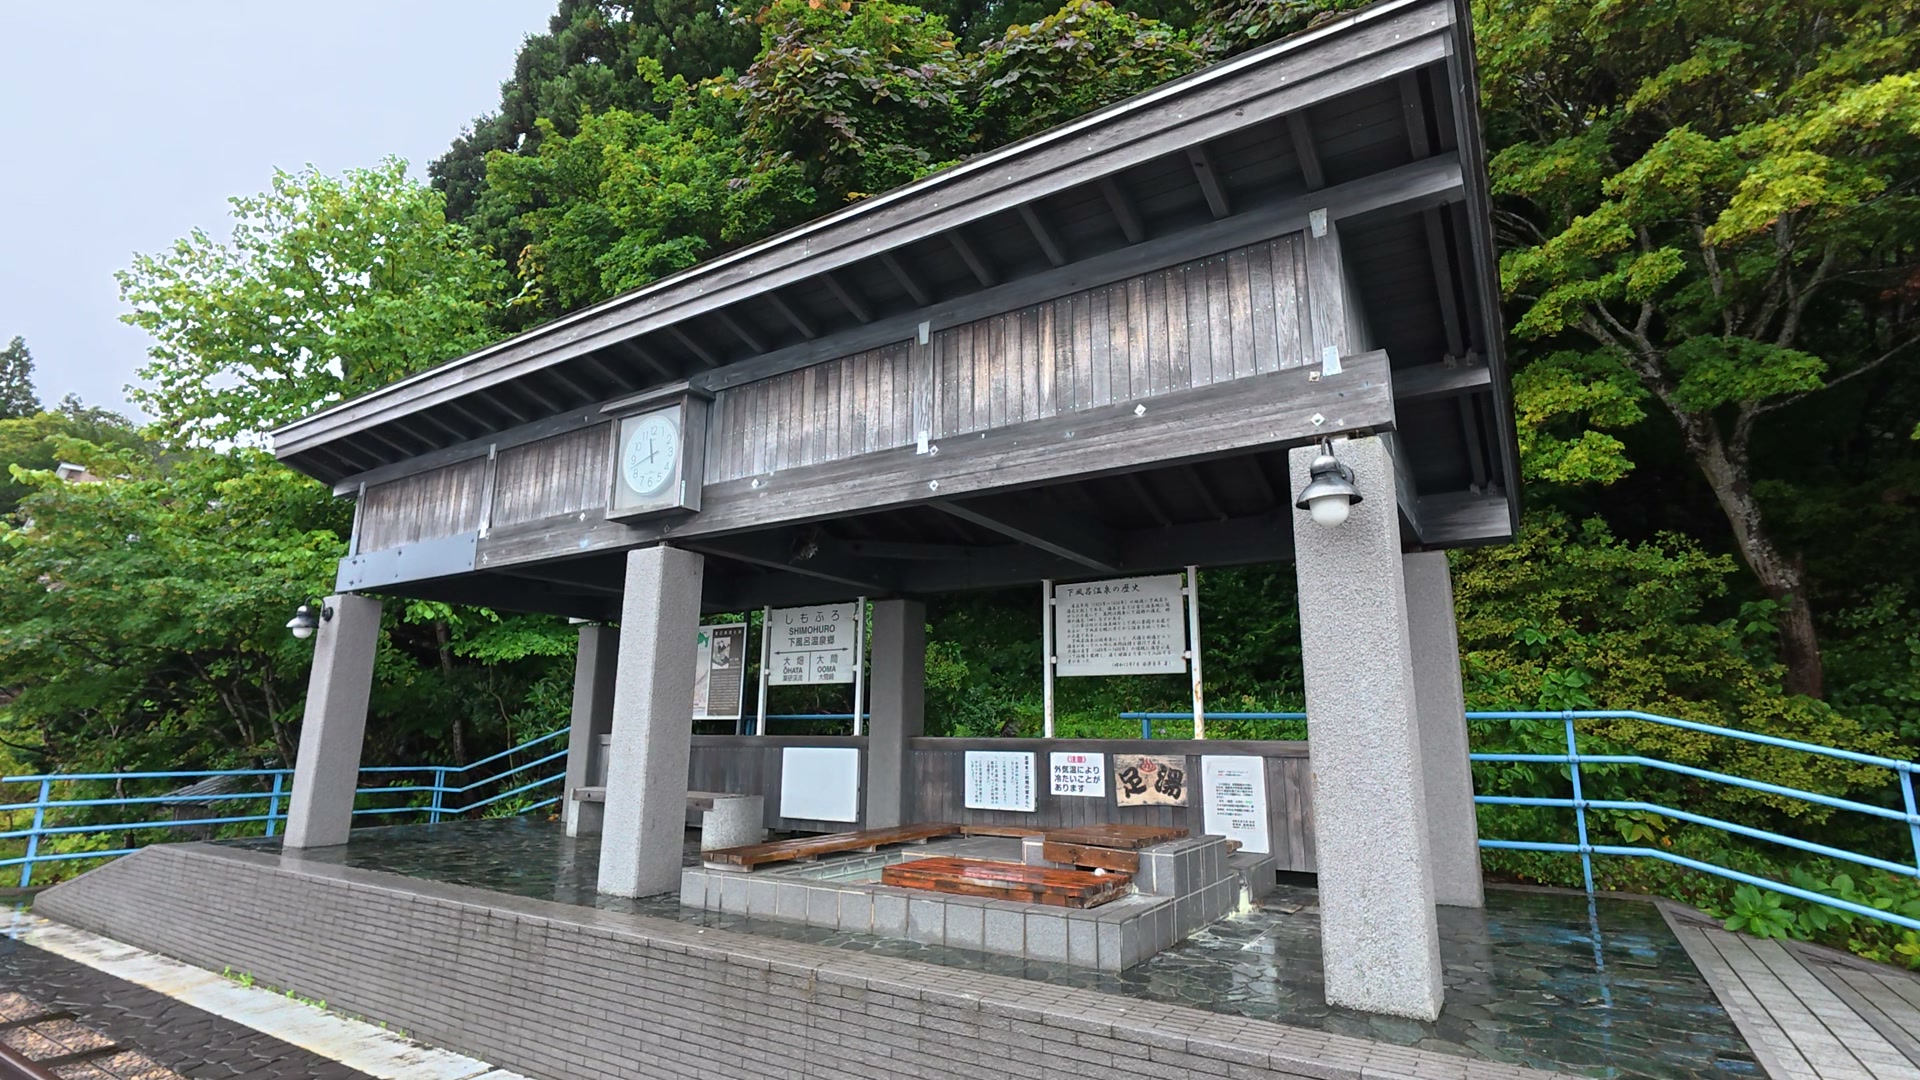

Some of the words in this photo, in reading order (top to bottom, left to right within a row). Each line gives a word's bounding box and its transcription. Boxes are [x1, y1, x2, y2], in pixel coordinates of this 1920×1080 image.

[651, 425, 657, 436] 12
[662, 426, 665, 437] 1
[643, 431, 648, 441] 11
[667, 434, 672, 445] 2
[636, 442, 641, 451] 10
[668, 447, 673, 457] 3
[631, 455, 636, 465] 9
[633, 469, 638, 479] 8
[657, 472, 662, 483] 5
[640, 476, 645, 487] 7
[647, 476, 653, 487] 6
[1067, 584, 1141, 597] 下風呂温泉の歴史
[788, 624, 836, 636] SHIMOHURO
[788, 635, 835, 647] 下風呂温泉郷
[817, 665, 836, 673] OOMA
[1054, 765, 1100, 775] 外気温により
[1054, 774, 1101, 784] 冷たいことが
[1054, 784, 1085, 793] あります
